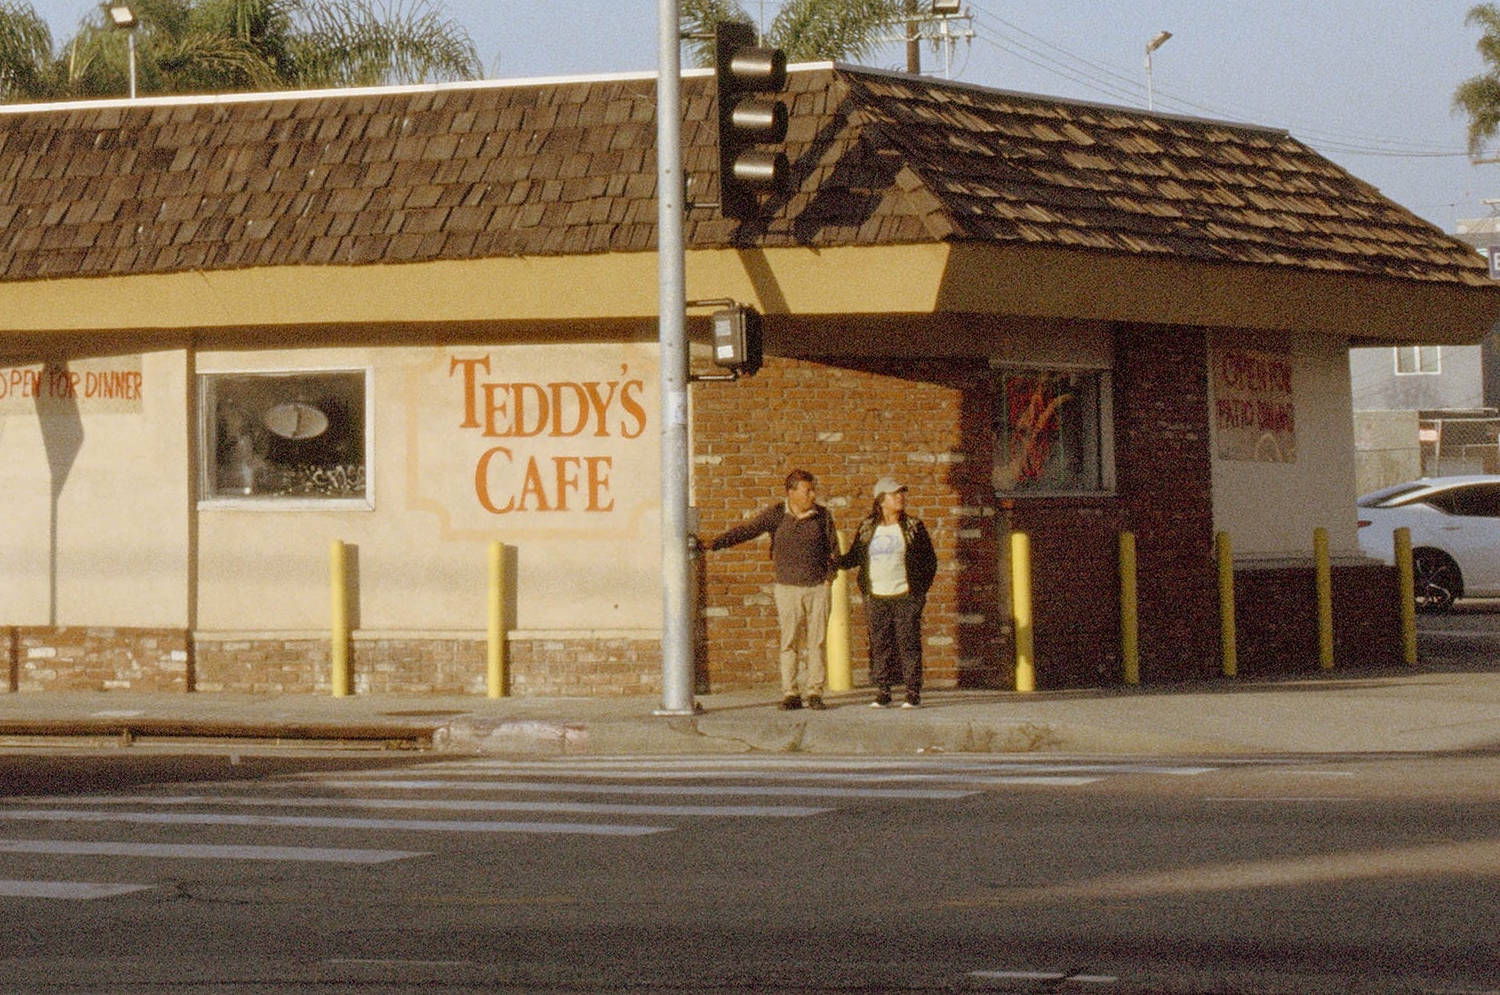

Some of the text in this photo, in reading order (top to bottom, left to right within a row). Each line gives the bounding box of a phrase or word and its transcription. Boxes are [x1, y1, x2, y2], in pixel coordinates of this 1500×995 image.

[84, 370, 143, 400] DINNER
[449, 353, 647, 439] TEDDY'S
[474, 446, 615, 515] CAFE
